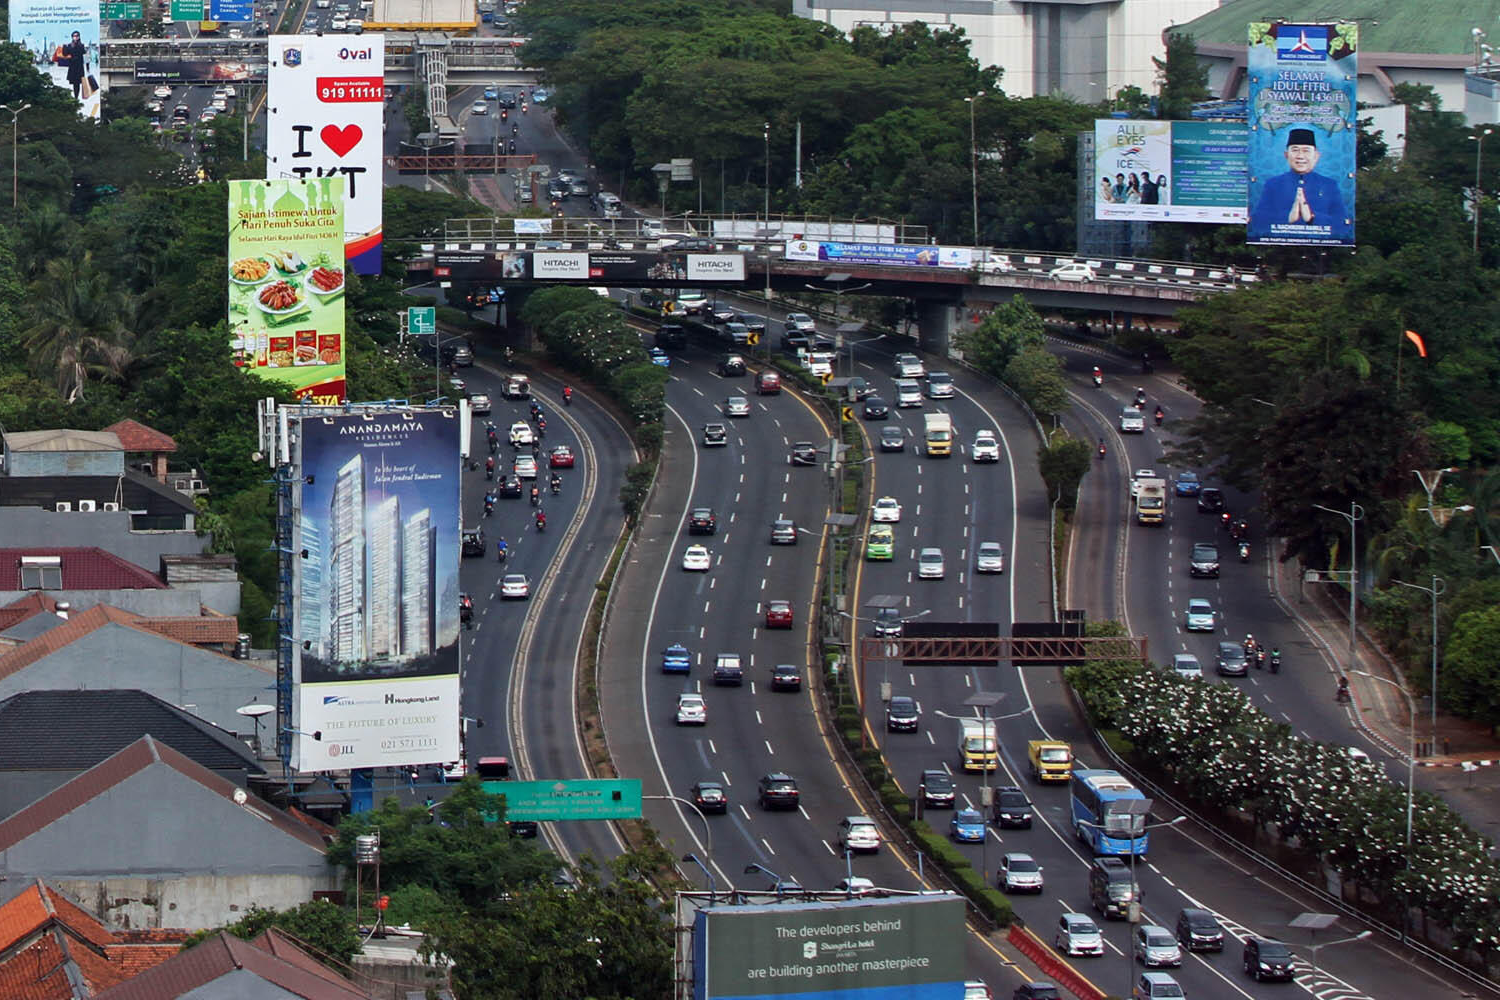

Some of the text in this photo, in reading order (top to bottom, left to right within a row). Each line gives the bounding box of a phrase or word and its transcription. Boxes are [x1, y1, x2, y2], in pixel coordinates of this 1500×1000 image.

[338, 48, 372, 60] Oval
[1278, 72, 1325, 81] SELAMAT
[1273, 81, 1331, 92] IDUL FITRI
[322, 88, 382, 98] 919 11111
[1268, 91, 1309, 101] SYAWAL
[1311, 91, 1333, 102] 1436
[1335, 93, 1344, 102] H
[1117, 125, 1138, 135] ALL
[292, 126, 313, 158] I
[1117, 136, 1146, 146] EYES
[1117, 160, 1134, 169] ICE
[238, 207, 337, 221] Sajian Istimewa Untuk
[242, 218, 335, 230] Hari Penuh Suka Cita
[340, 422, 424, 435] ANANDAMAYA
[409, 464, 417, 472] of
[395, 697, 425, 705] Hongkong
[326, 716, 437, 729] THE FUTURE OF LUXURY
[381, 738, 437, 749] 021 571 1111
[341, 746, 355, 755] JLL
[775, 920, 901, 938] The developers behind
[858, 940, 875, 948] hotel
[748, 956, 930, 979] are building another masterpiece
